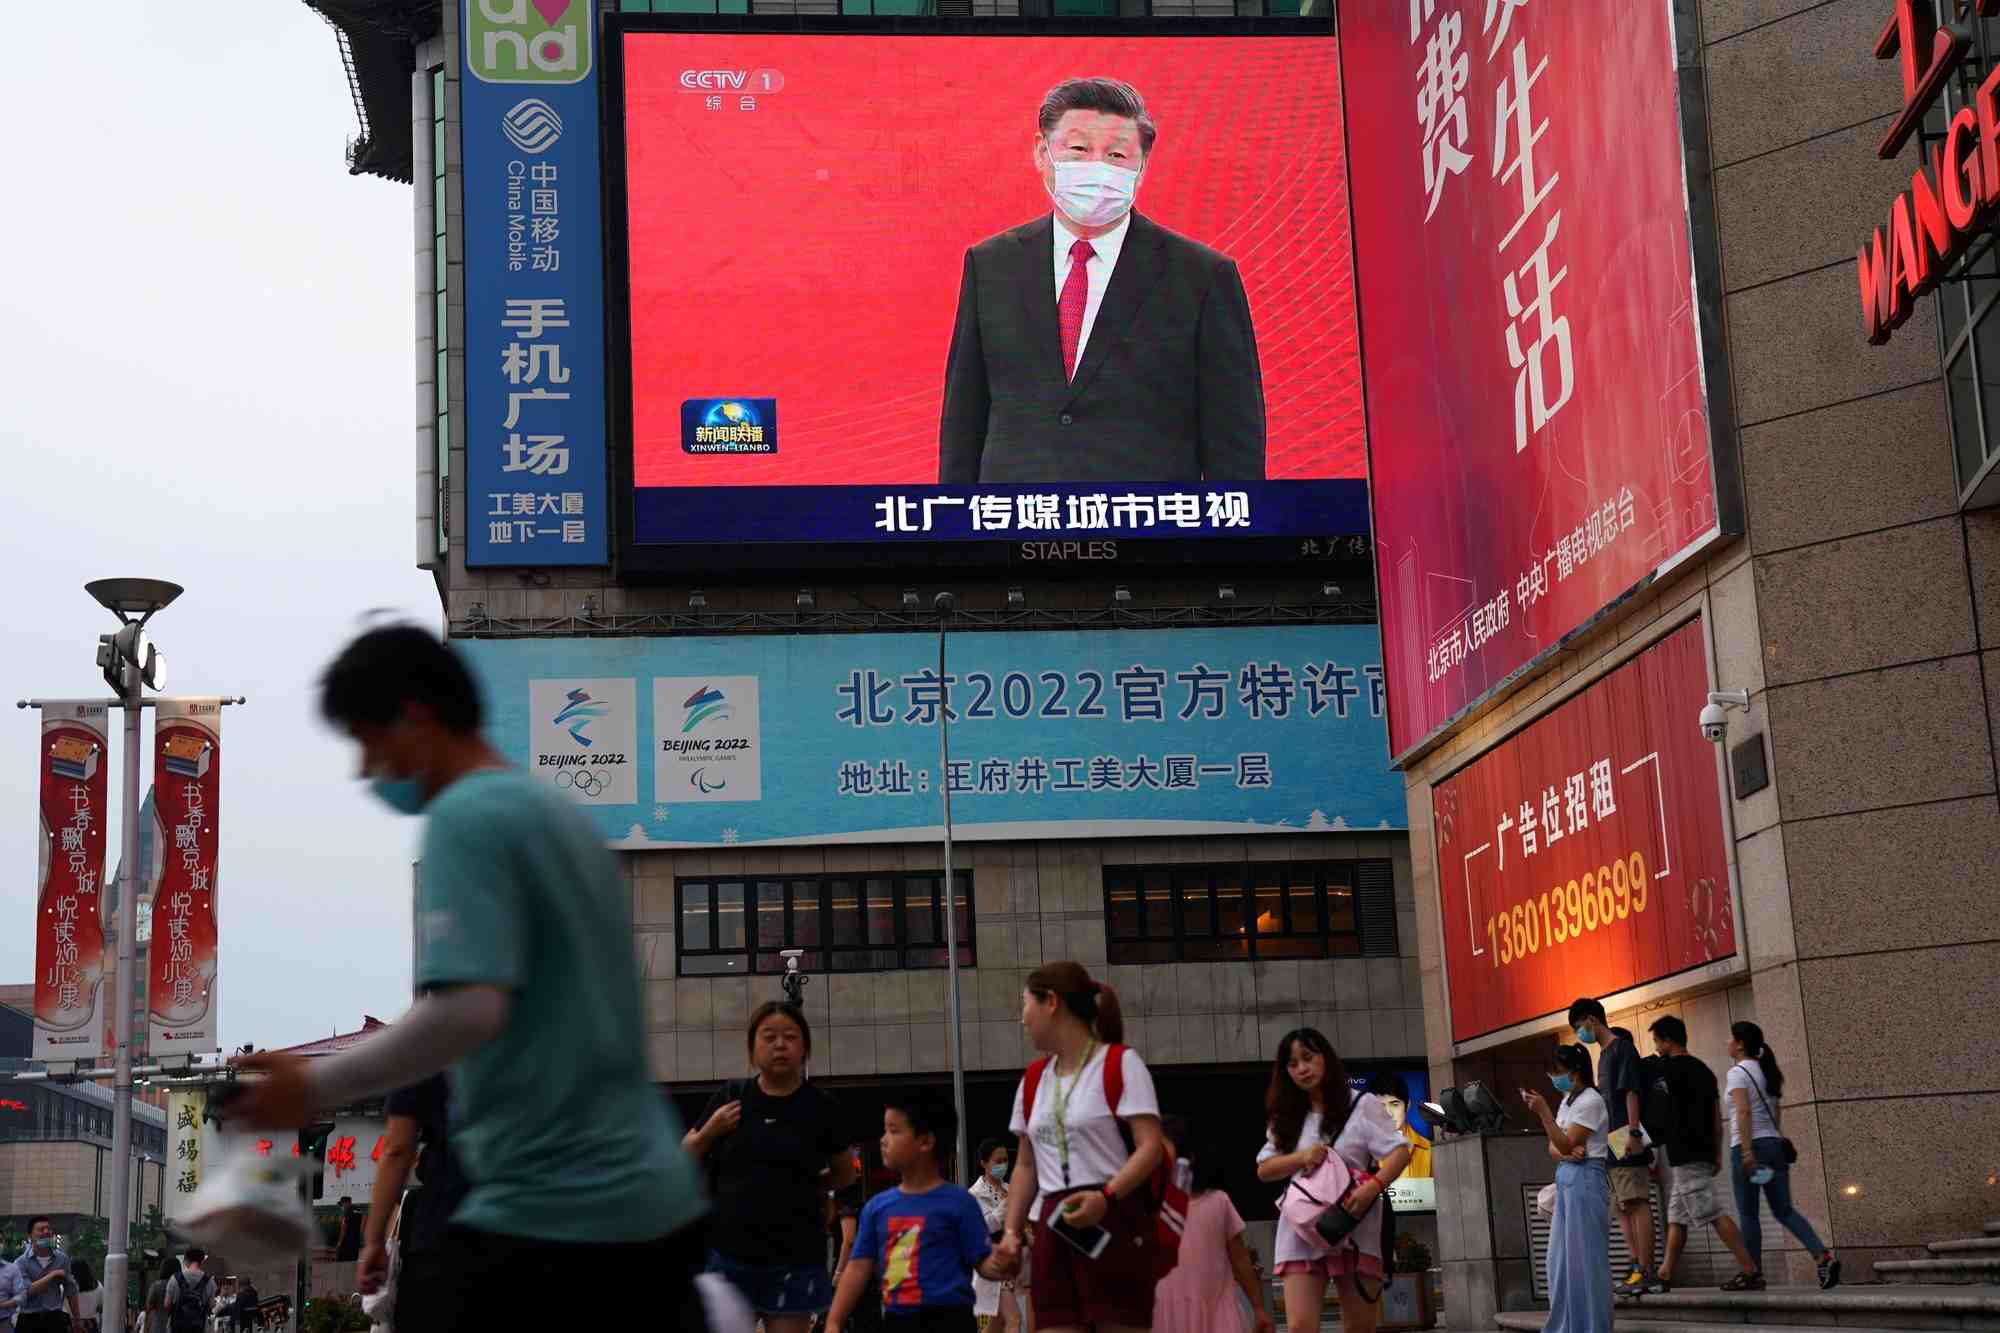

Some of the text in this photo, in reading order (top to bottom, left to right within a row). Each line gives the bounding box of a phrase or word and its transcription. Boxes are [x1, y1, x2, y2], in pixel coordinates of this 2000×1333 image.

[680, 70, 770, 90] CCTV 1
[704, 95, 758, 111] 综合
[508, 160, 527, 271] China Mobile
[531, 161, 560, 272] 中国移动
[501, 298, 570, 476] 手机广场
[695, 425, 764, 443] 新闻联播
[488, 492, 584, 516] 工美大厦
[874, 491, 1251, 532] 北广传媒城市电视
[488, 519, 585, 545] 地下一层
[1021, 541, 1117, 560] STAPLES
[1427, 486, 1636, 684] 北京市人民政府 中央广播电视总台
[539, 753, 627, 769] BEIJING 2022
[663, 738, 750, 754] BEIJING 2022
[1496, 757, 1617, 871] 广告位招租
[61, 784, 96, 894] 书香飘京城
[175, 780, 209, 891] 书香飘京城
[1487, 851, 1648, 968] 13601396699
